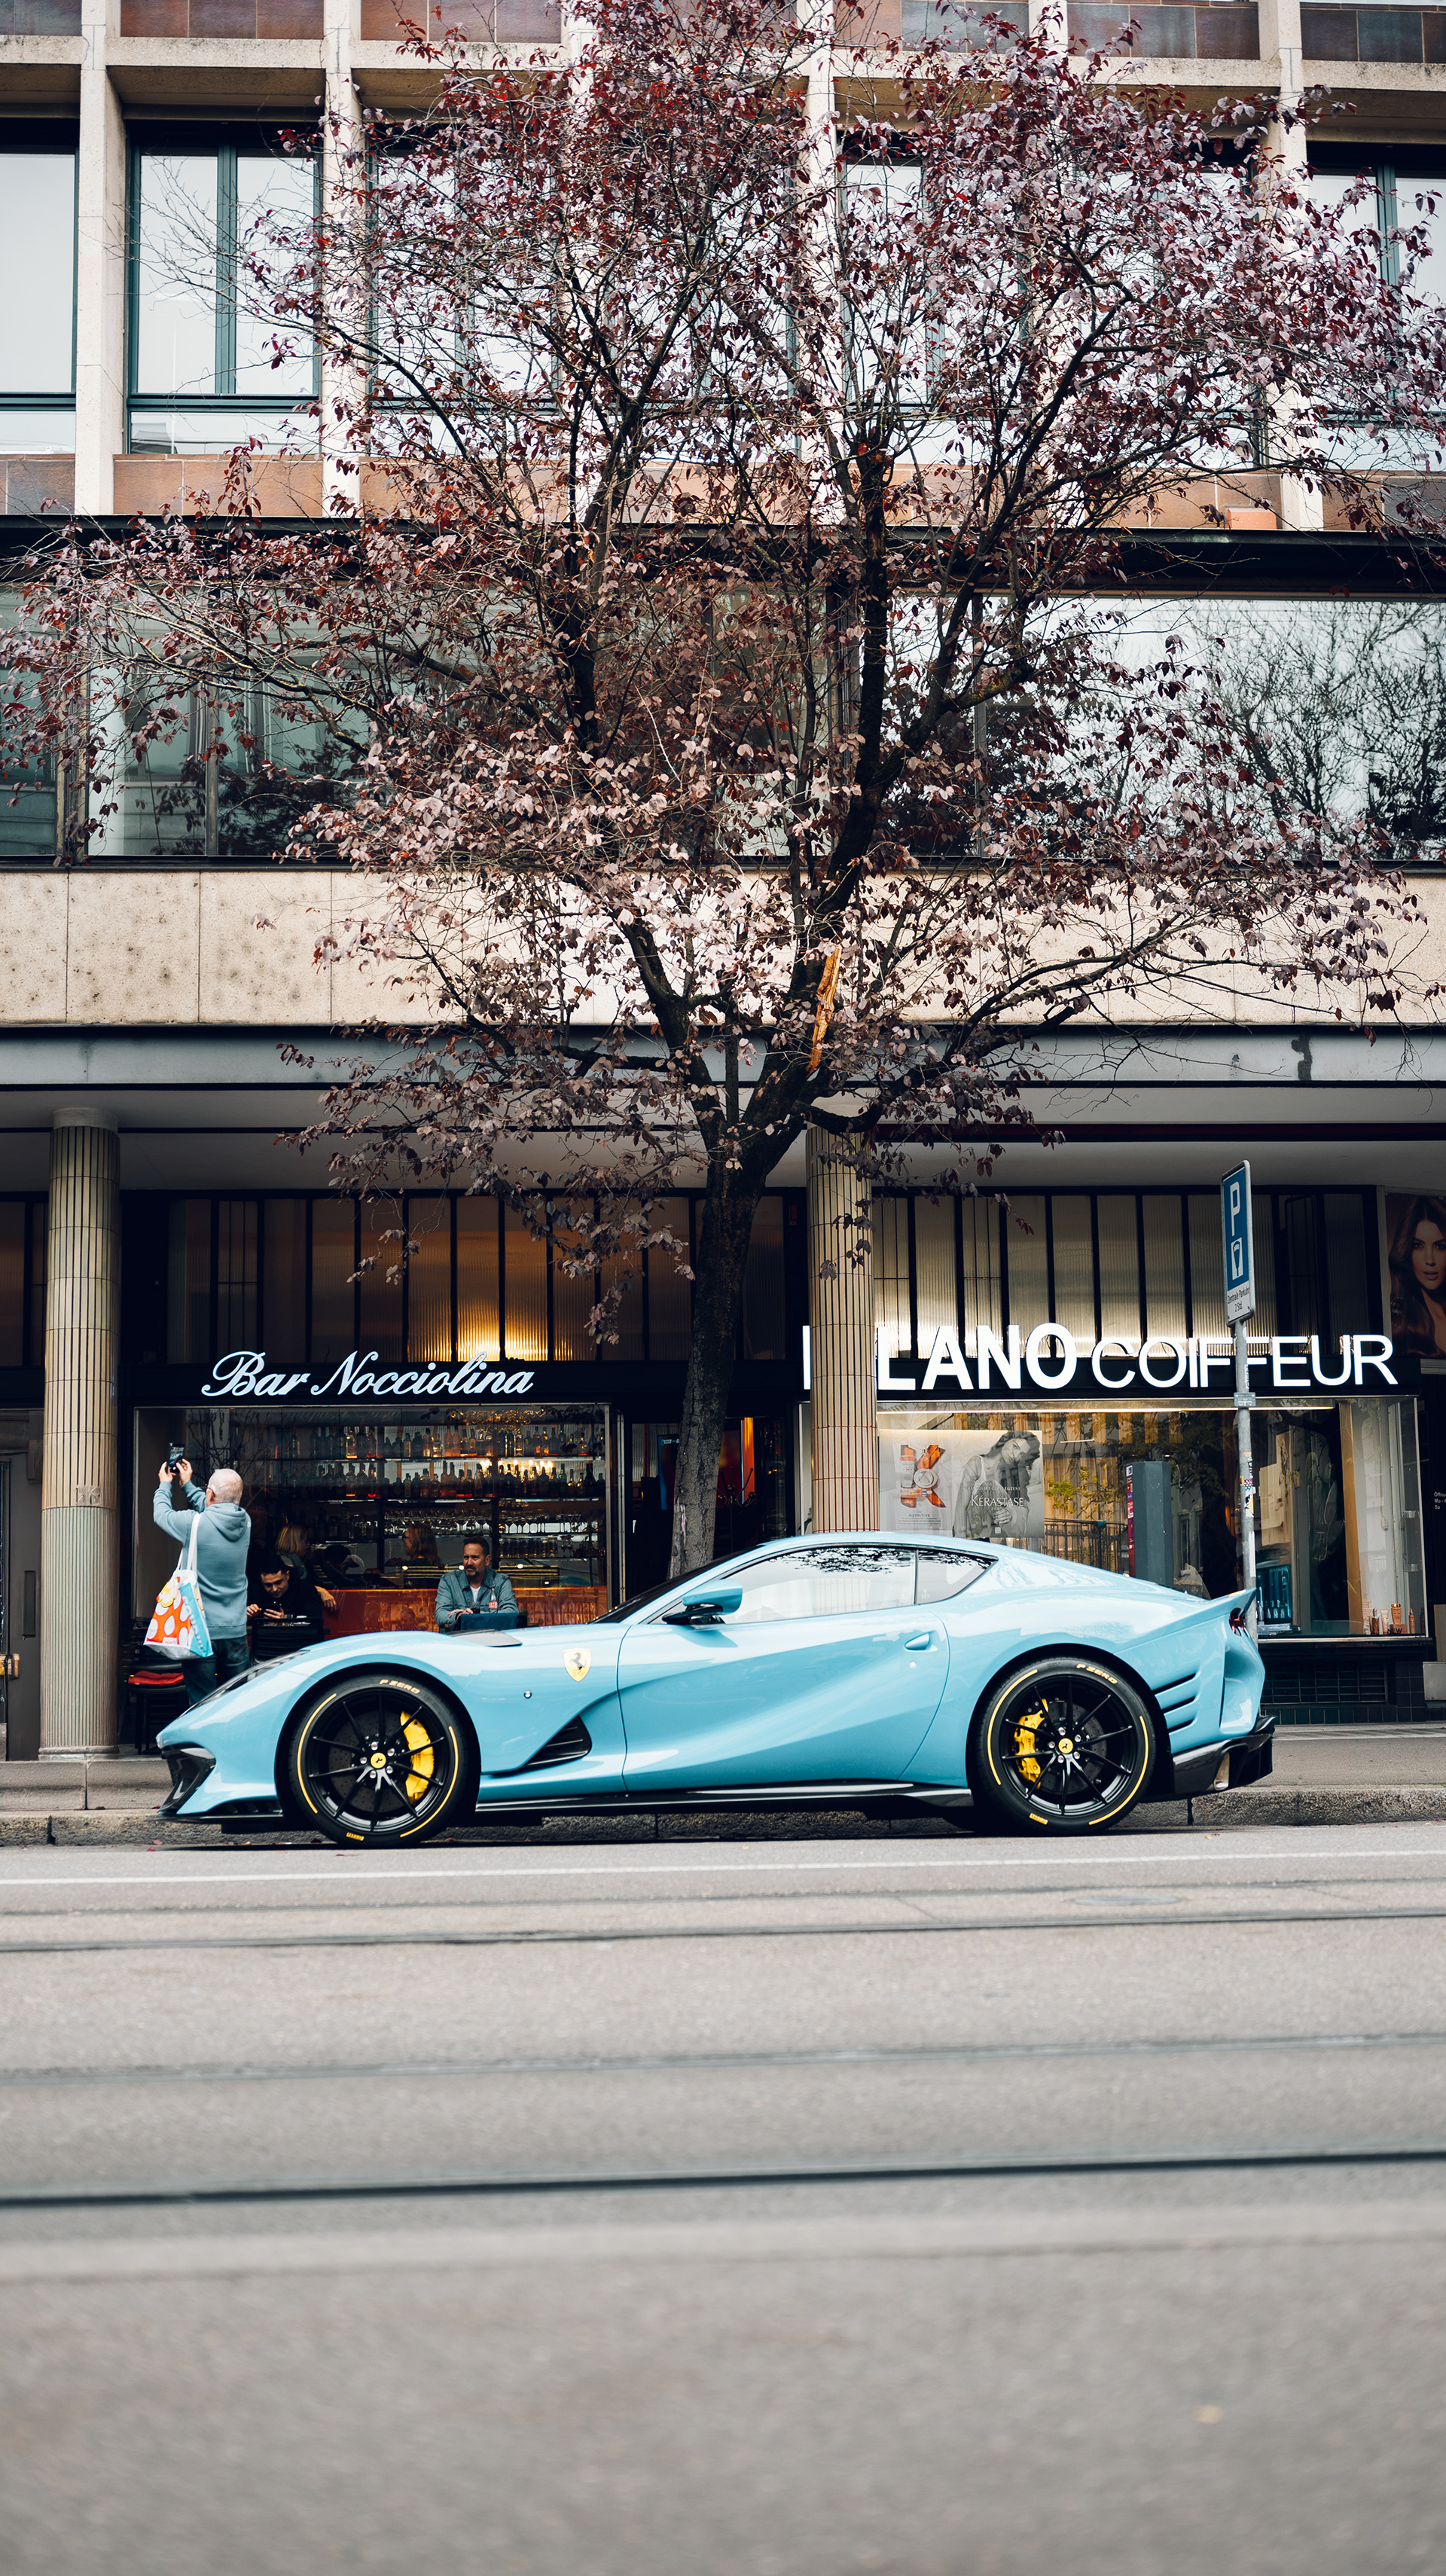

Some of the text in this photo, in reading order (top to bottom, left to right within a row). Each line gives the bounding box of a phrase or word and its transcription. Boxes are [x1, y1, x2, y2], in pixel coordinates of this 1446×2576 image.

[1230, 1181, 1240, 1237] P
[802, 1323, 1078, 1390] LANO
[201, 1351, 535, 1396] Bar Nocciolina
[971, 1494, 1024, 1506] KÉRASTASE
[389, 1680, 421, 1694] ZERO
[1086, 1665, 1118, 1684] ZERO
